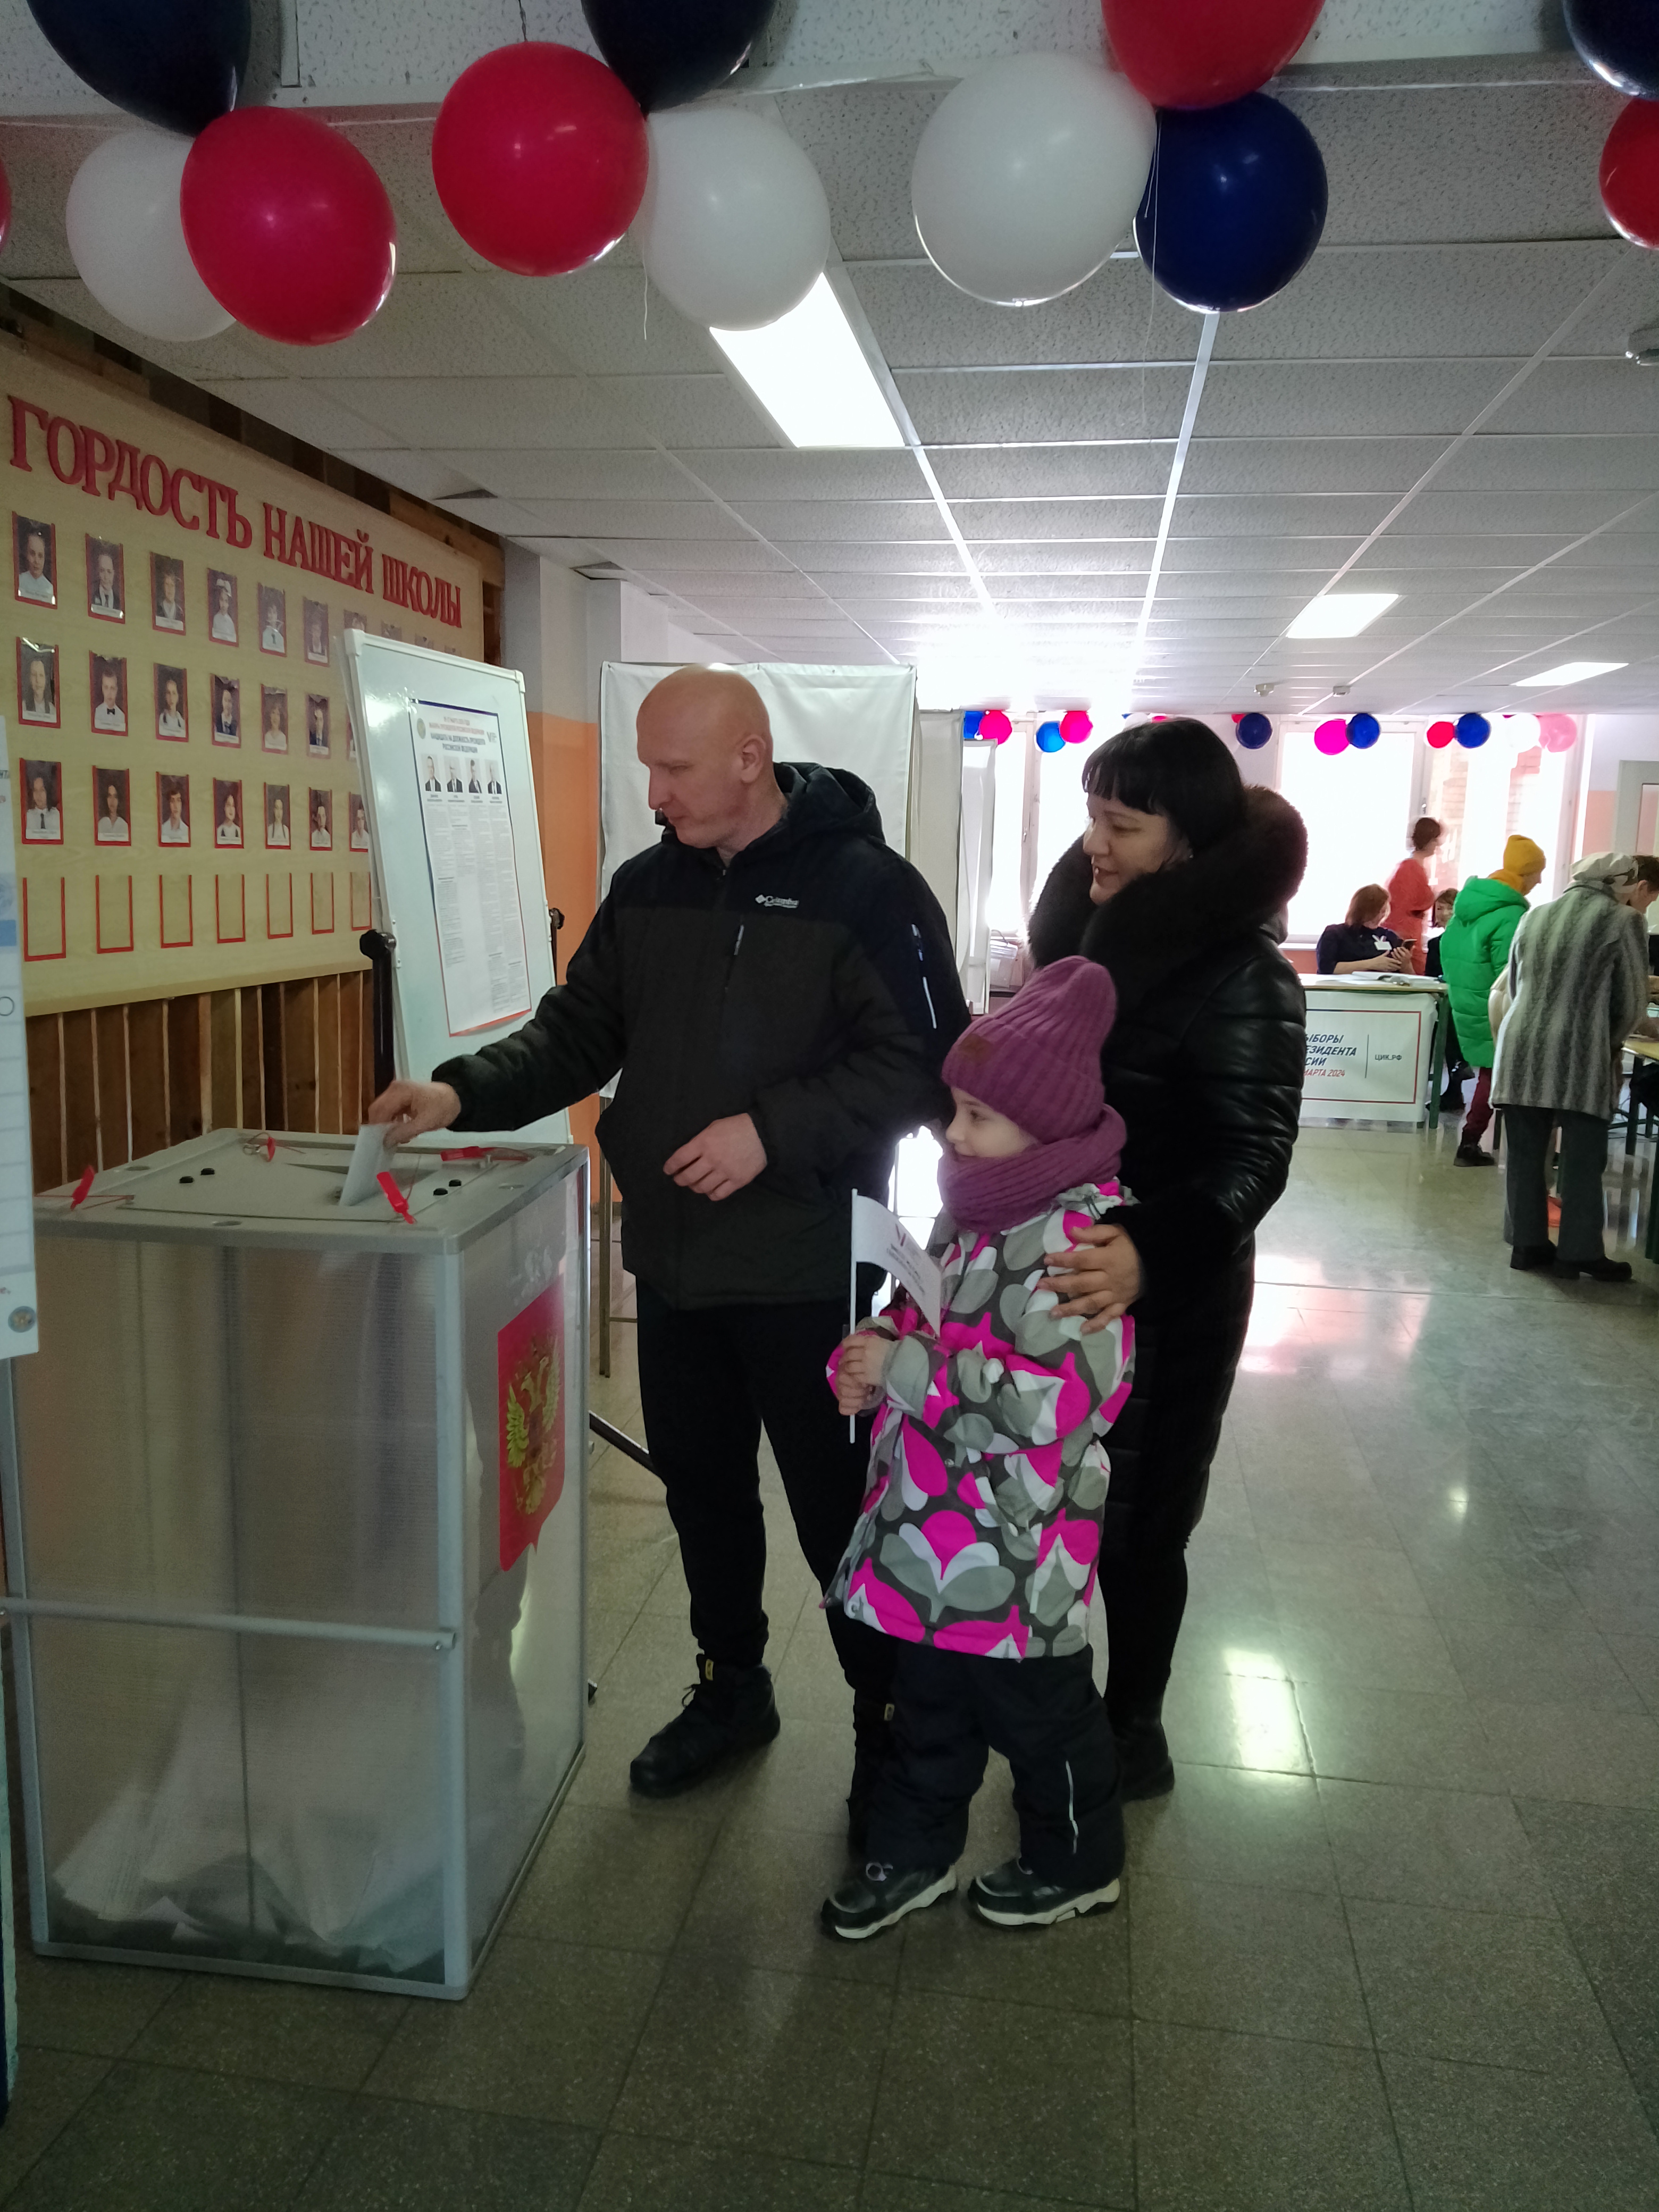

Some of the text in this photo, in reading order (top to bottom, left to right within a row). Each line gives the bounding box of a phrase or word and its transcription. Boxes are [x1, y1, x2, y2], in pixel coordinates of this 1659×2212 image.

[7, 395, 462, 629] ГОРДОСТЬ НАШЕЙ ШКОЛЫ
[1305, 1034, 1344, 1043] ЫБОРЫ
[1306, 1045, 1357, 1056] ЕЗИДЕНТА
[1305, 1057, 1327, 1066] СИИ
